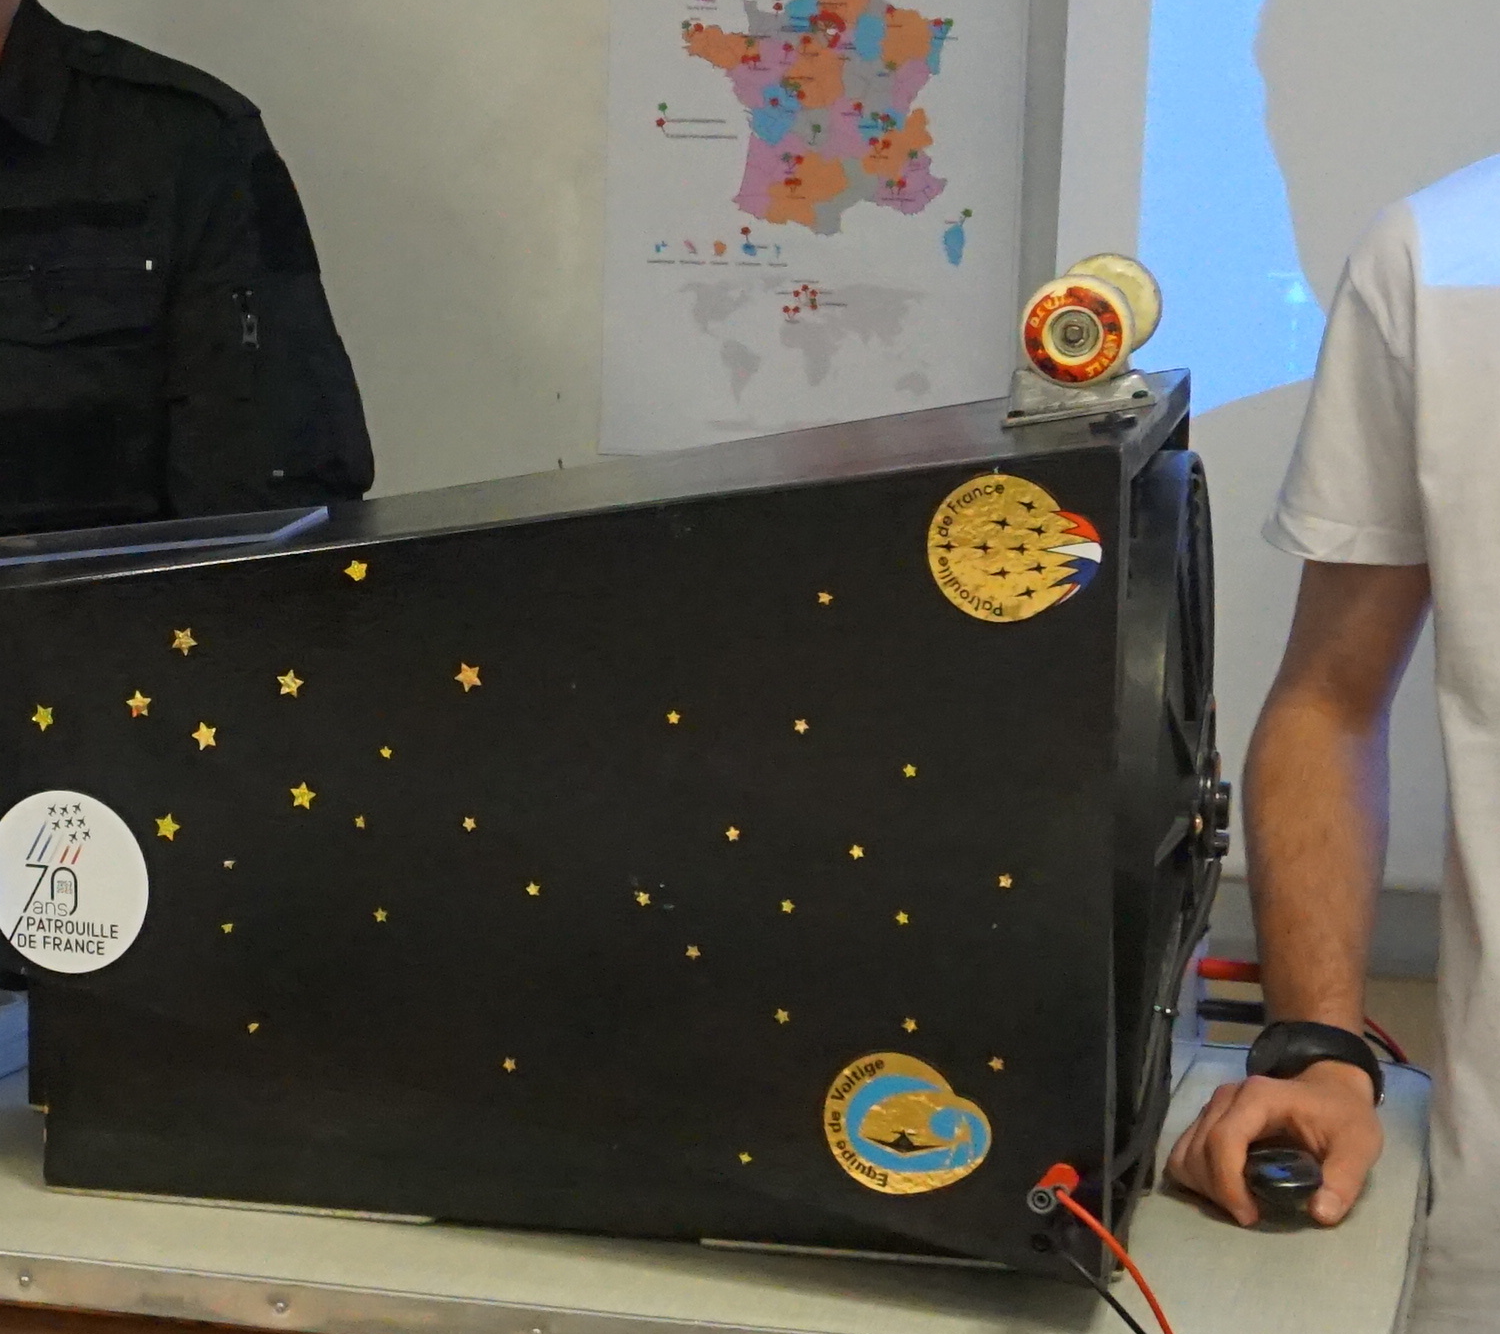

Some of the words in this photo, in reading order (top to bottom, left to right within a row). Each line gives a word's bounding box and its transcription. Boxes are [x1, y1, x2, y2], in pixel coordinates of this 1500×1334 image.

[947, 483, 1005, 515] France
[937, 515, 954, 538] de
[937, 555, 1004, 617] Patrouille
[32, 900, 69, 917] ans
[25, 916, 120, 940] PATROUILLE
[16, 933, 37, 950] DE
[42, 935, 105, 956] FRANCE
[830, 1058, 886, 1103] Voltige
[827, 1110, 842, 1134] de
[836, 1140, 889, 1188] Equipe
